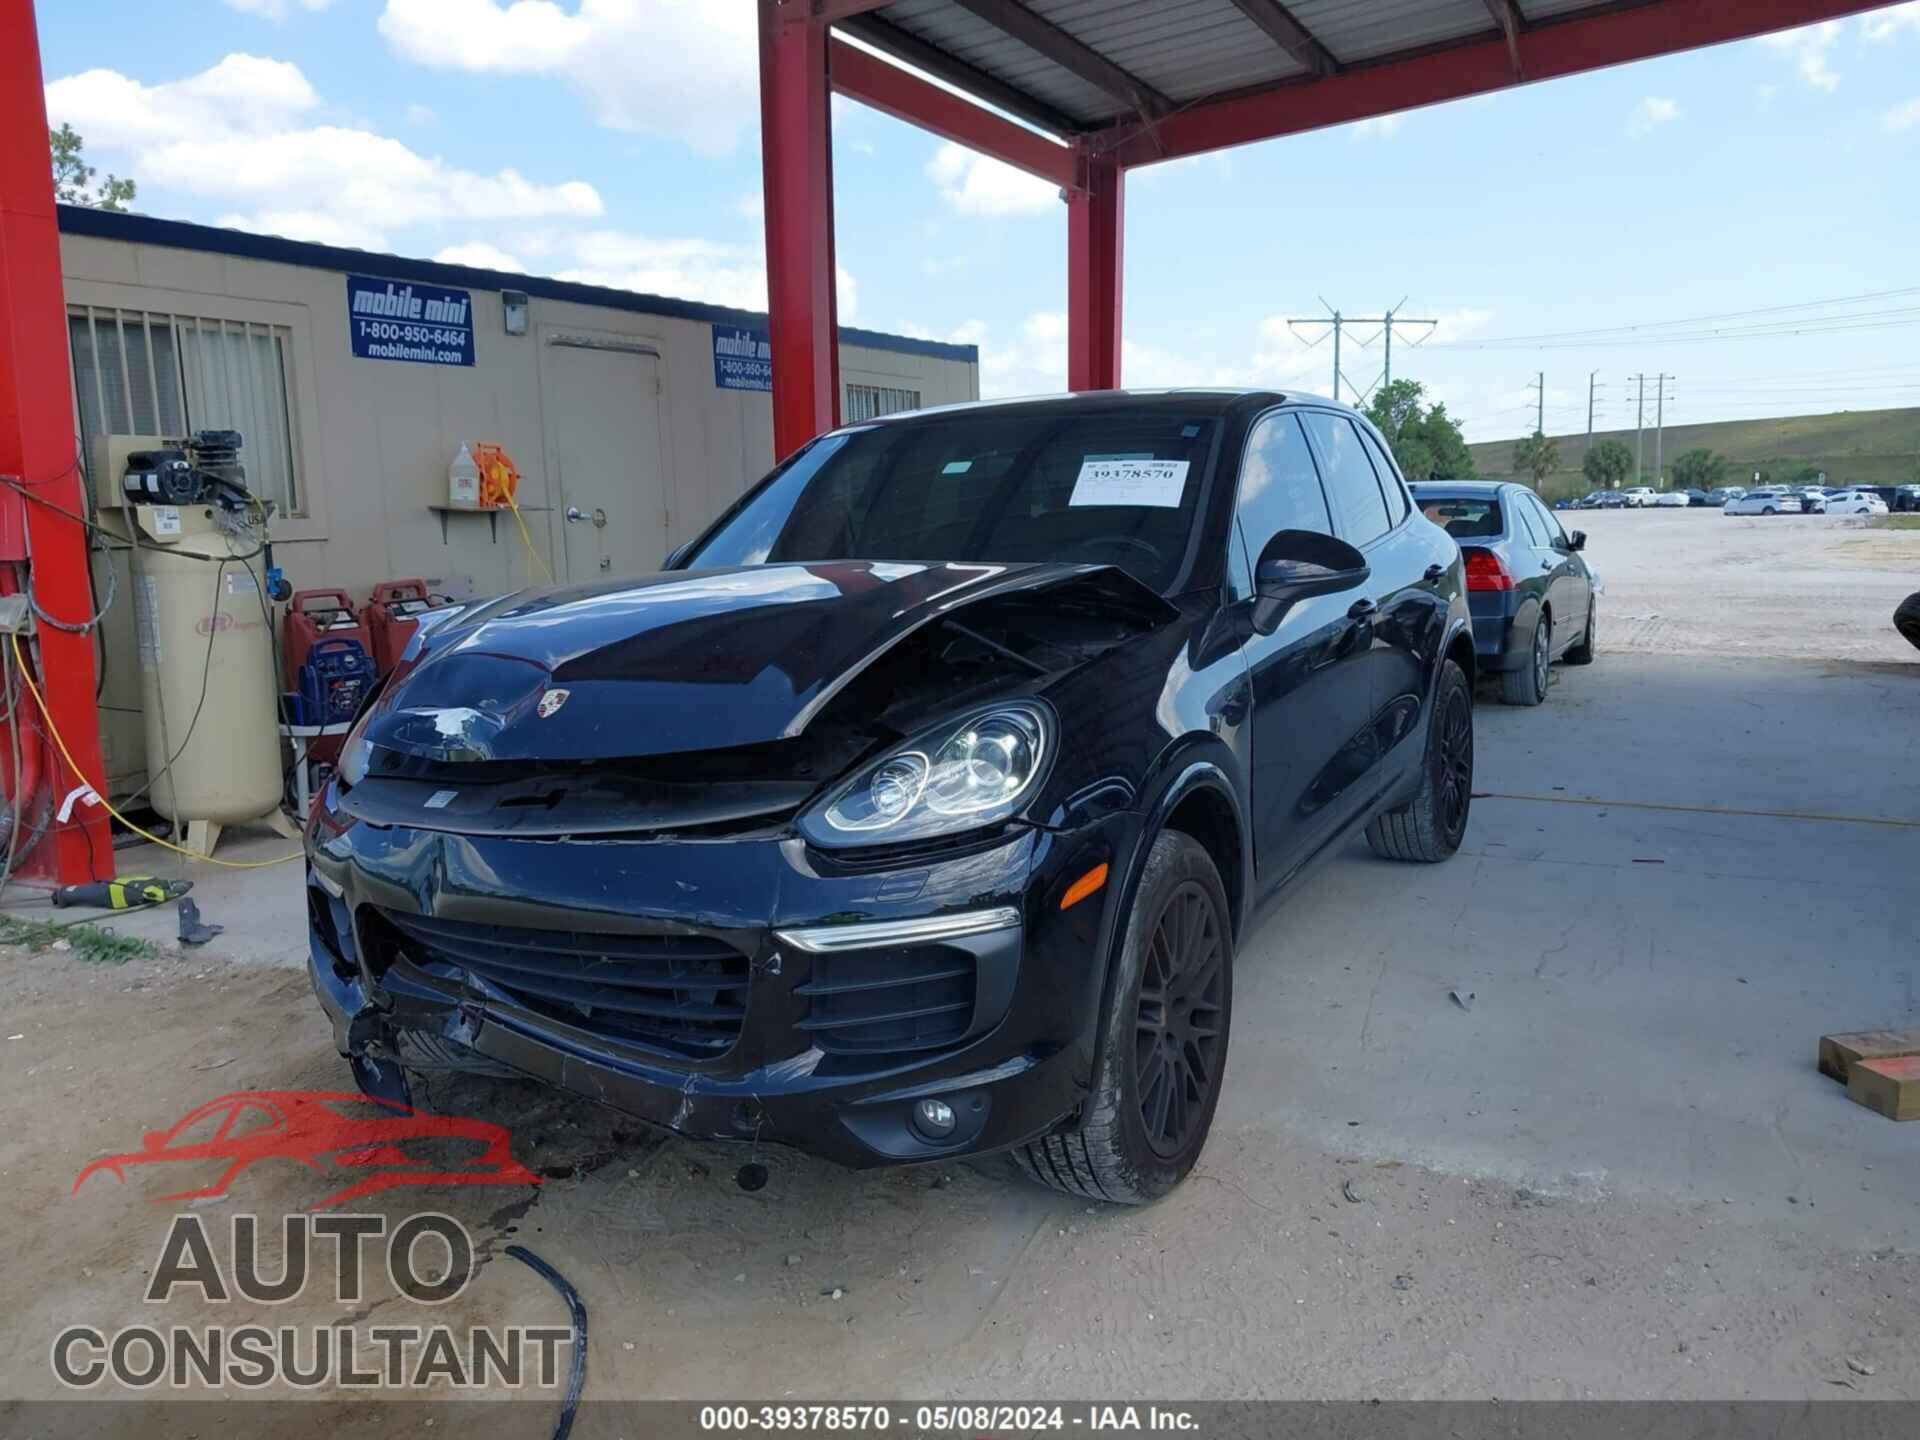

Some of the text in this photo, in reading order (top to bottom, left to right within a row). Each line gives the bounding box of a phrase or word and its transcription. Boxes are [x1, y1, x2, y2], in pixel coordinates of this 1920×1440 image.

[352, 283, 469, 324] mobile mini
[359, 321, 466, 346] 1-800-950-6464
[715, 330, 757, 358] mobile
[368, 342, 462, 363] mobilemini.com
